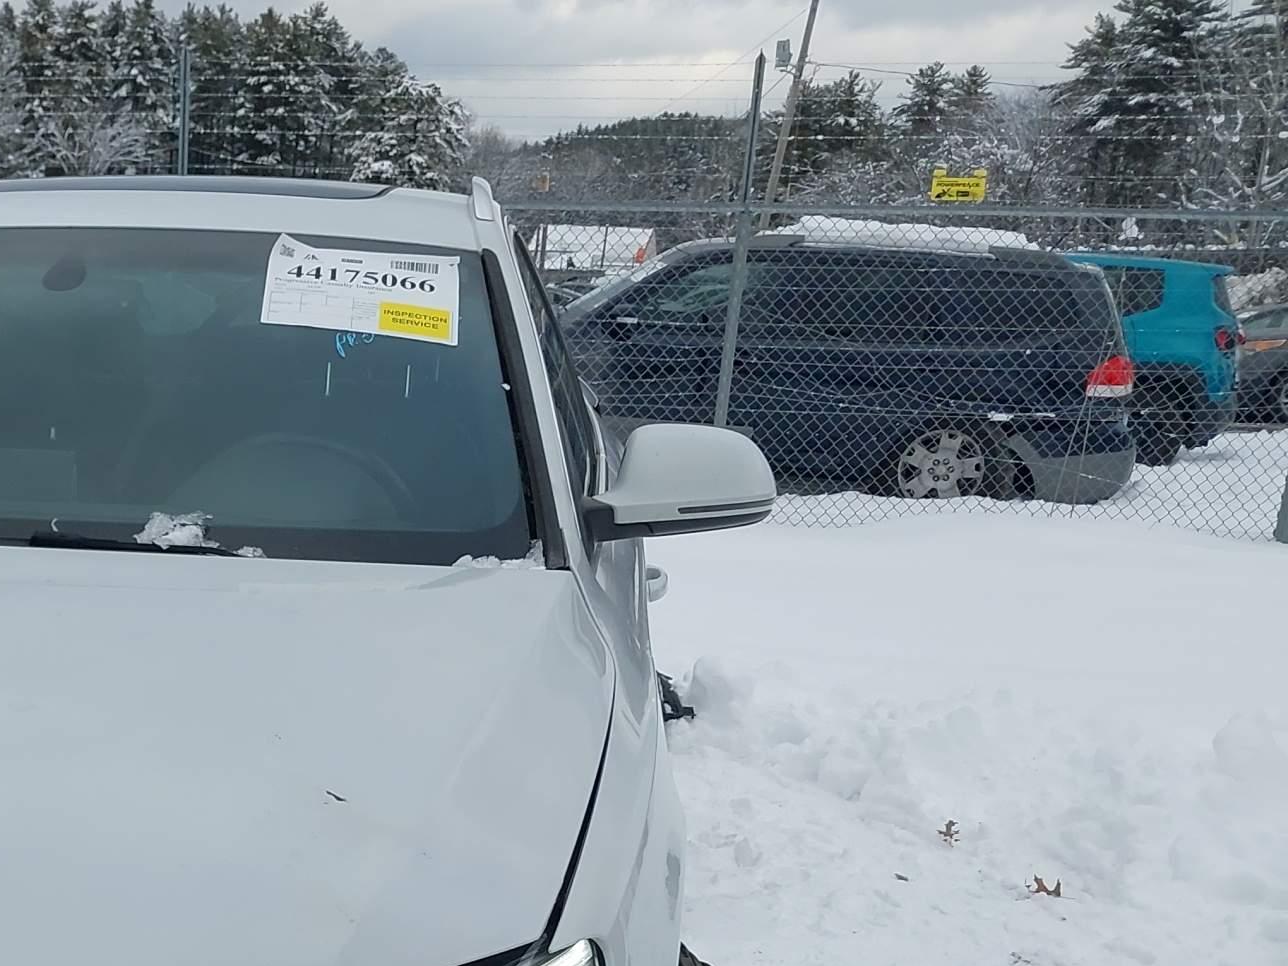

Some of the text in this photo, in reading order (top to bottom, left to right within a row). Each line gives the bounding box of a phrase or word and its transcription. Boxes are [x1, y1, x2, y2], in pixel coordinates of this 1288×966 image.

[287, 265, 435, 293] 44175066
[383, 309, 447, 323] INSPECTION
[391, 317, 439, 329] SERVICE
